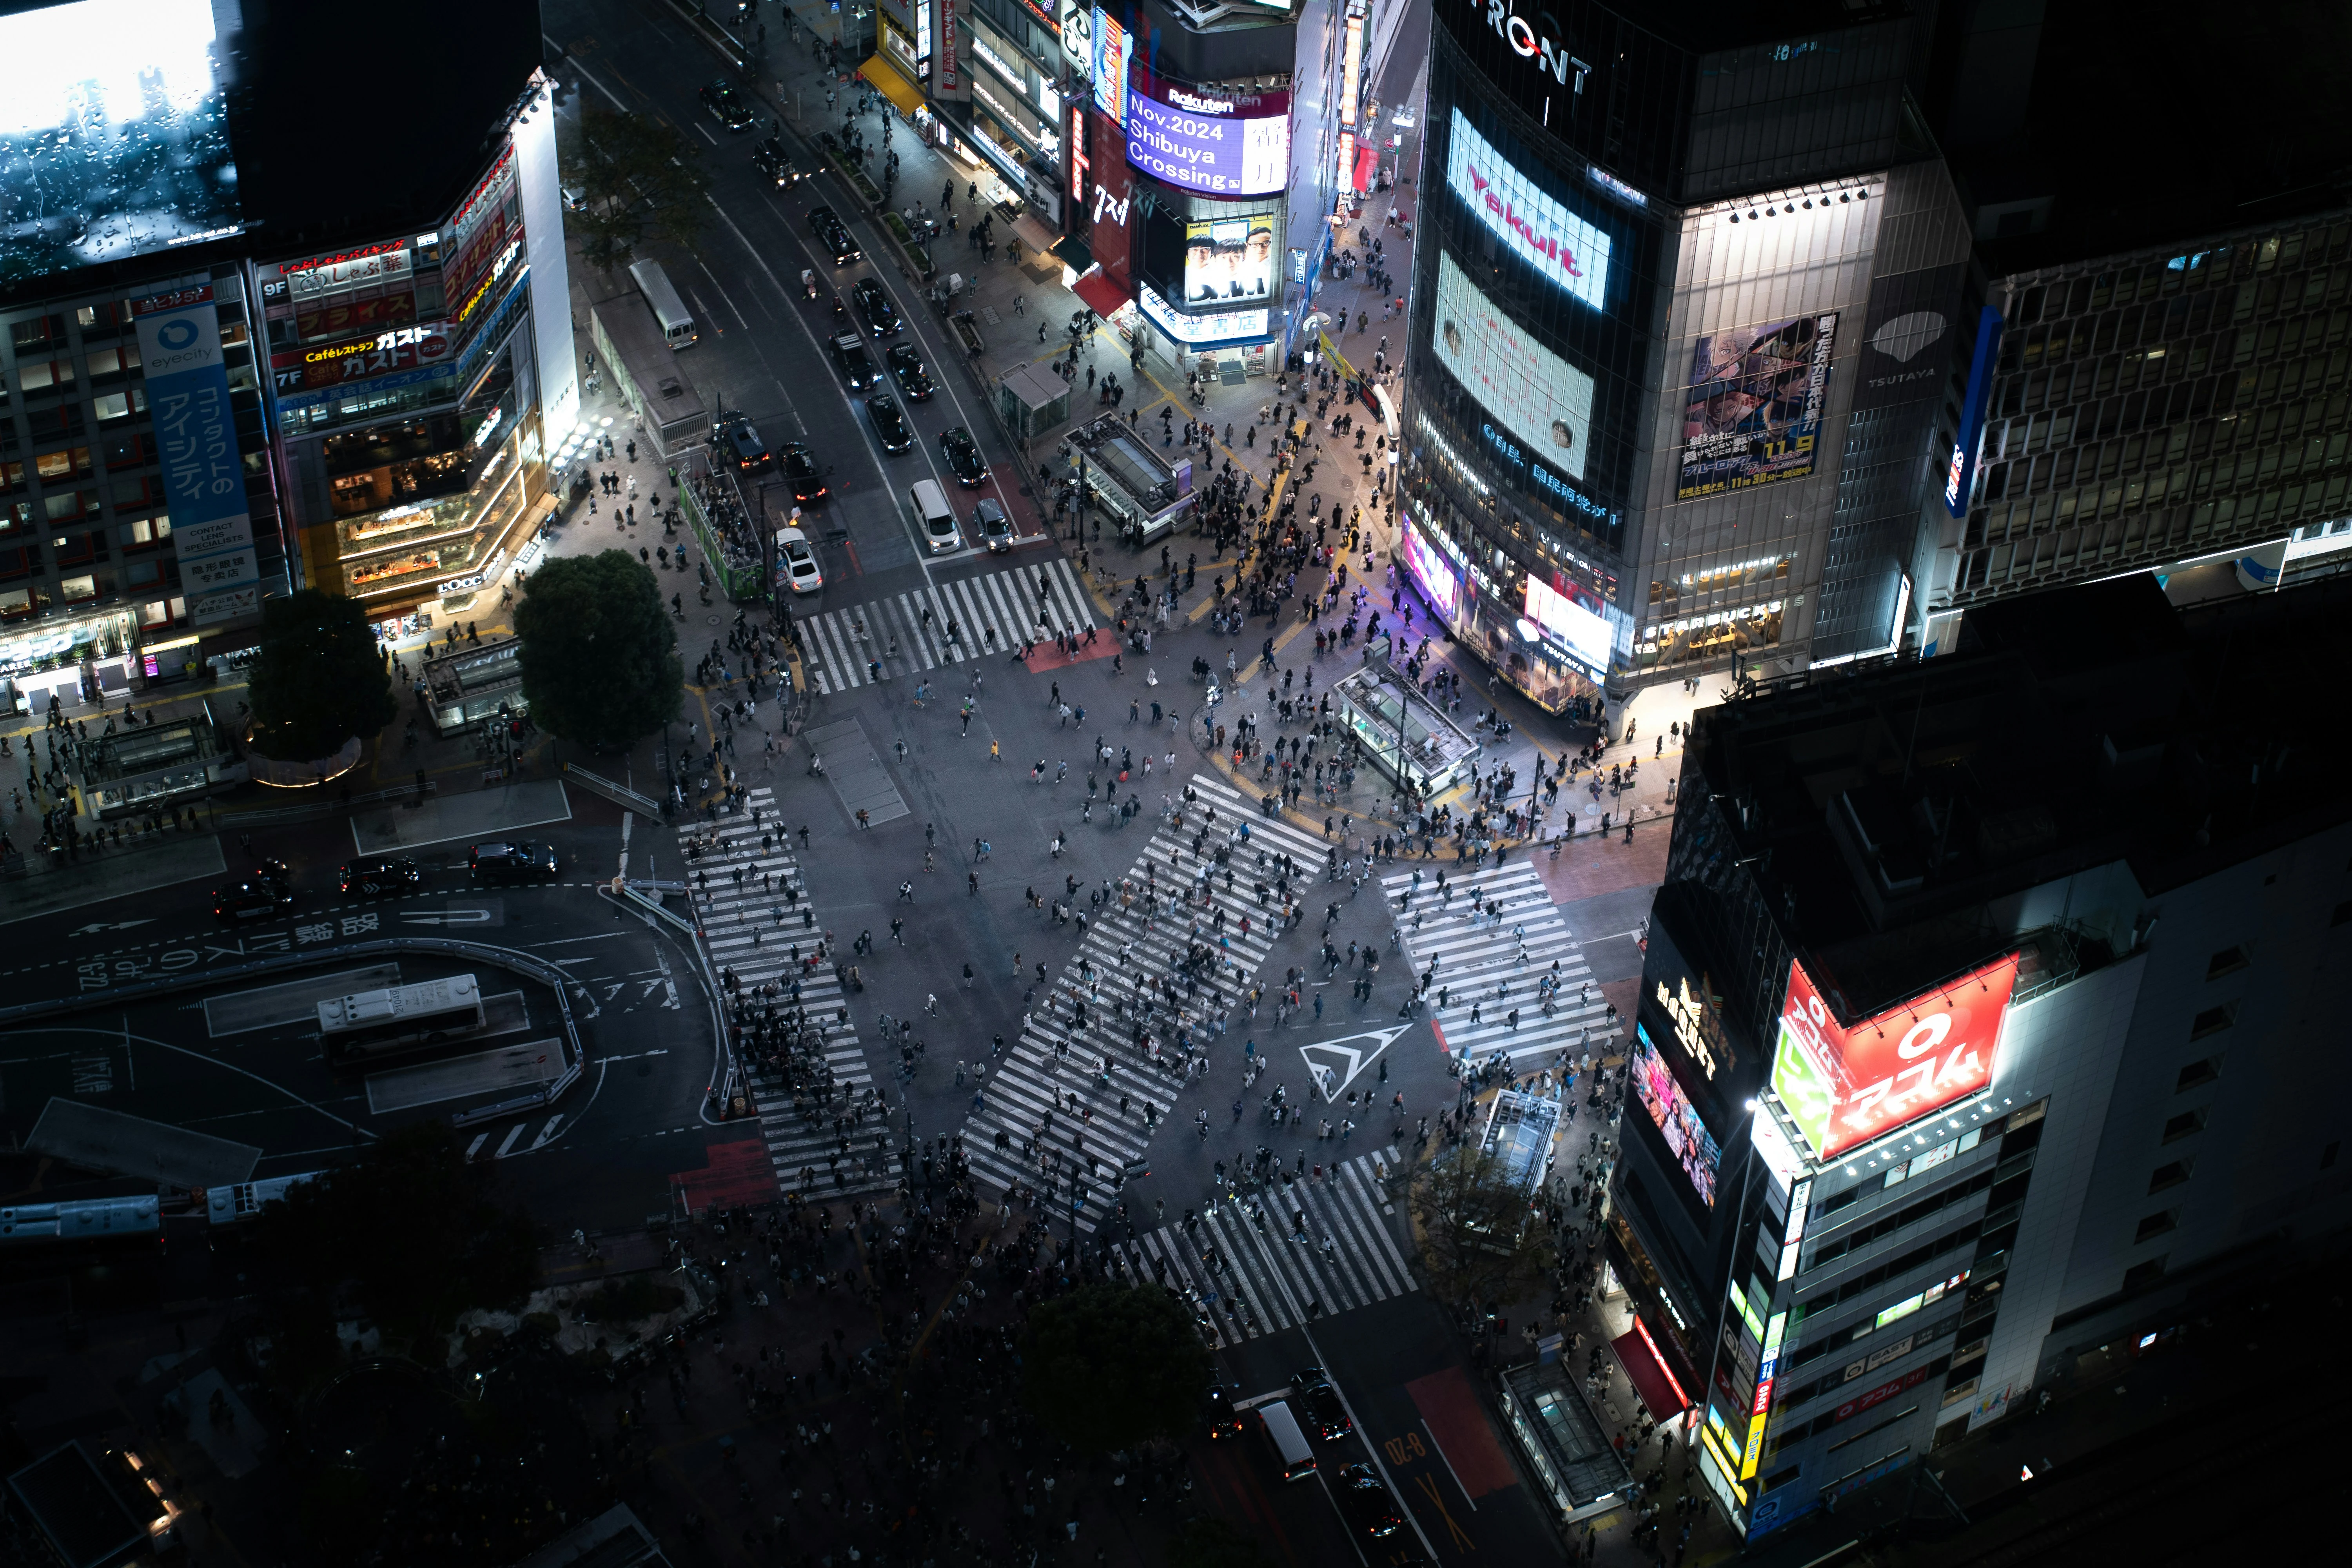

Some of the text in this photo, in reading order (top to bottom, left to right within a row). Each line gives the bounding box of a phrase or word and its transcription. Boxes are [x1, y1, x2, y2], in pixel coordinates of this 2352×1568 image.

[1105, 23, 1117, 119] 三千里薬品
[1169, 89, 1234, 113] Rakuten
[1131, 94, 1223, 140] Nov.2024
[1131, 118, 1215, 164] Shibuya
[1130, 141, 1227, 190] Crossing
[1467, 163, 1583, 278] Yakult
[279, 239, 405, 274] しゃぶしゃぶバイキング
[332, 254, 403, 282] しゃぶ葉
[493, 241, 520, 281] ガスト
[264, 281, 286, 296] 9F
[298, 295, 410, 333] プライス
[377, 327, 432, 351] ガスト
[152, 348, 212, 368] eyecity
[343, 350, 410, 377] ガスト
[276, 370, 301, 387] 7F
[285, 367, 449, 409] AEON 英会話イーオン 6F
[1869, 368, 1936, 388] TSUTAYA
[159, 393, 205, 499] アイシティ
[198, 387, 234, 494] コンタクトの
[1690, 432, 1734, 450] 絶対に
[1765, 435, 1815, 459] 11.9
[1683, 454, 1753, 477] ブルーロック
[1776, 456, 1813, 469] JAPAN
[185, 534, 243, 552] SPECIALISTS
[190, 522, 234, 537] CONTACT
[201, 531, 225, 541] LENS
[1415, 499, 1501, 597] STARBUCKS
[192, 556, 245, 575] 隐形眼镜
[200, 568, 239, 583] 专卖店
[201, 596, 234, 607] ハチ公前
[1645, 601, 1782, 638] STARBUCKS
[1543, 642, 1585, 673] TSUTAYA
[1792, 996, 1834, 1073] アコム
[1847, 1043, 1979, 1124] アコム
[1872, 1339, 1909, 1362] EAST
[1862, 1371, 1924, 1406] アコム 3F
[1746, 1430, 1762, 1463] プロミス
